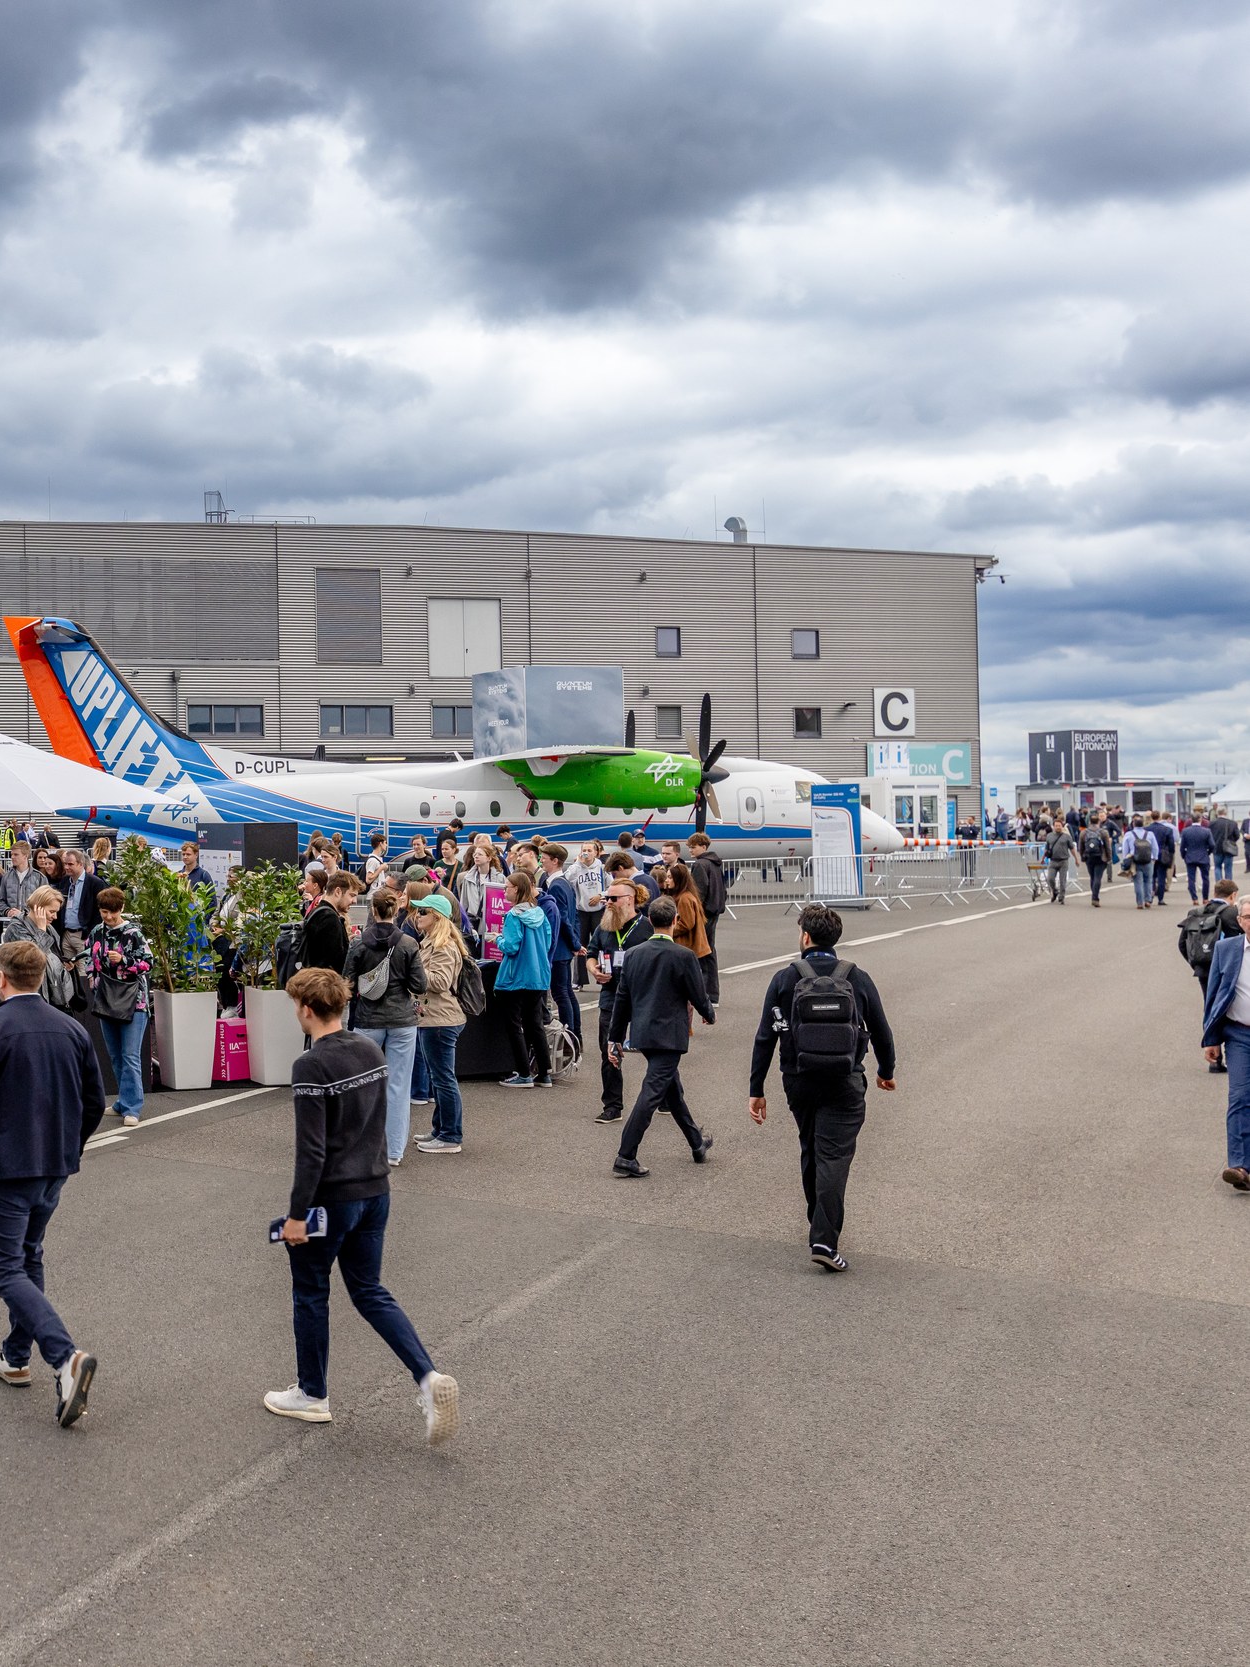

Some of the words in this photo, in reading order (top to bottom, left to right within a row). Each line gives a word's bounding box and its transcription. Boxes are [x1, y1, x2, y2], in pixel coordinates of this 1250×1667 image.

[881, 691, 909, 731] C
[71, 653, 183, 816] UPLIFT
[1074, 733, 1117, 742] EUROPEAN
[1074, 742, 1117, 751] AUTONOMY
[235, 760, 296, 775] D-CUPL
[909, 763, 937, 775] TION
[941, 749, 965, 781] C
[665, 778, 684, 787] DLR
[182, 816, 199, 825] DLR
